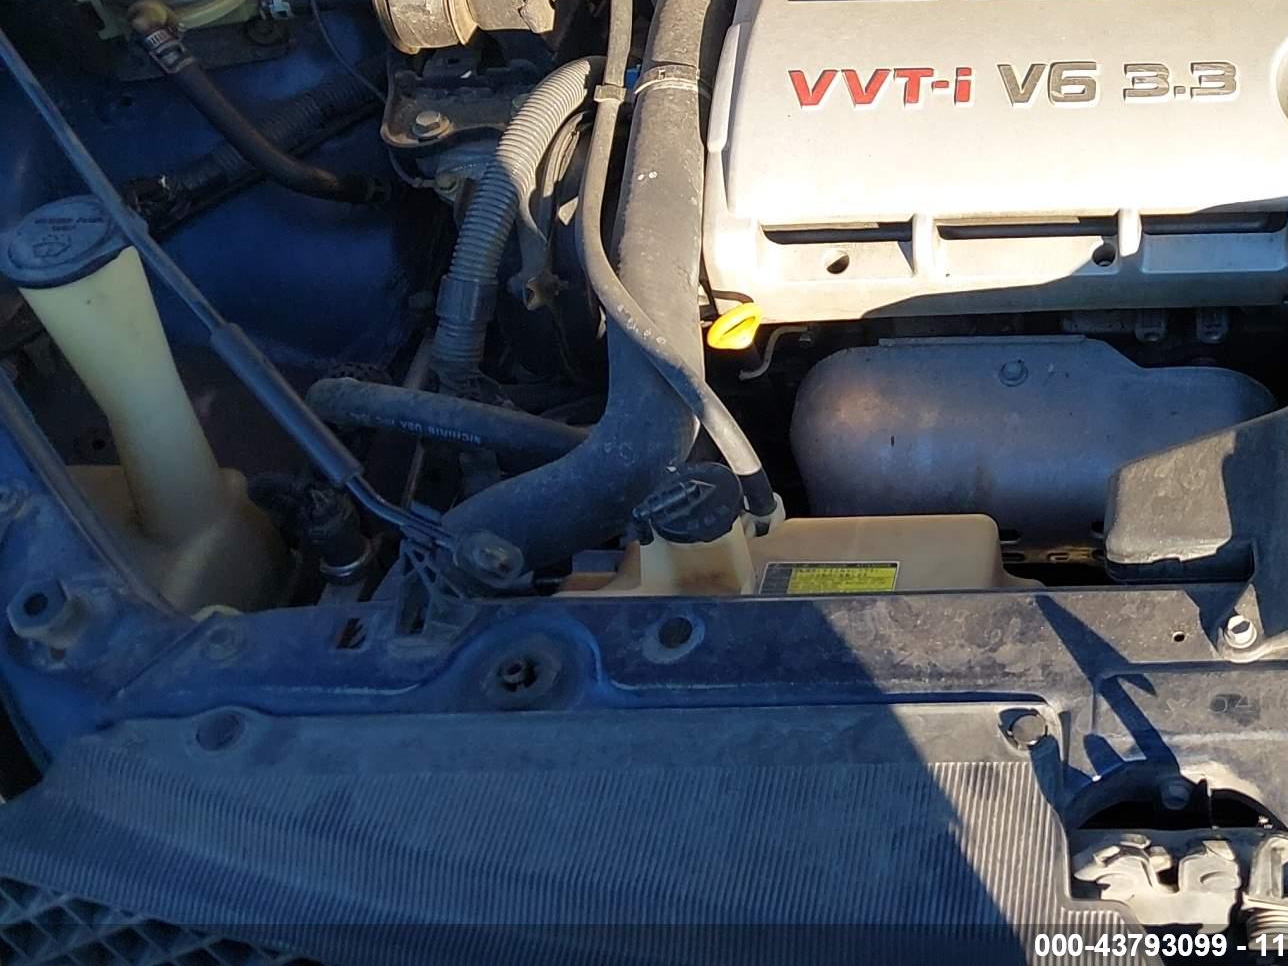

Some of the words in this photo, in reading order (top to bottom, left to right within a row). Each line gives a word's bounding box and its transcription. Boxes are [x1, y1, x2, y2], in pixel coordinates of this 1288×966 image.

[788, 67, 972, 106] VVT-i
[998, 62, 1098, 104] V6
[1123, 61, 1238, 100] 3.3
